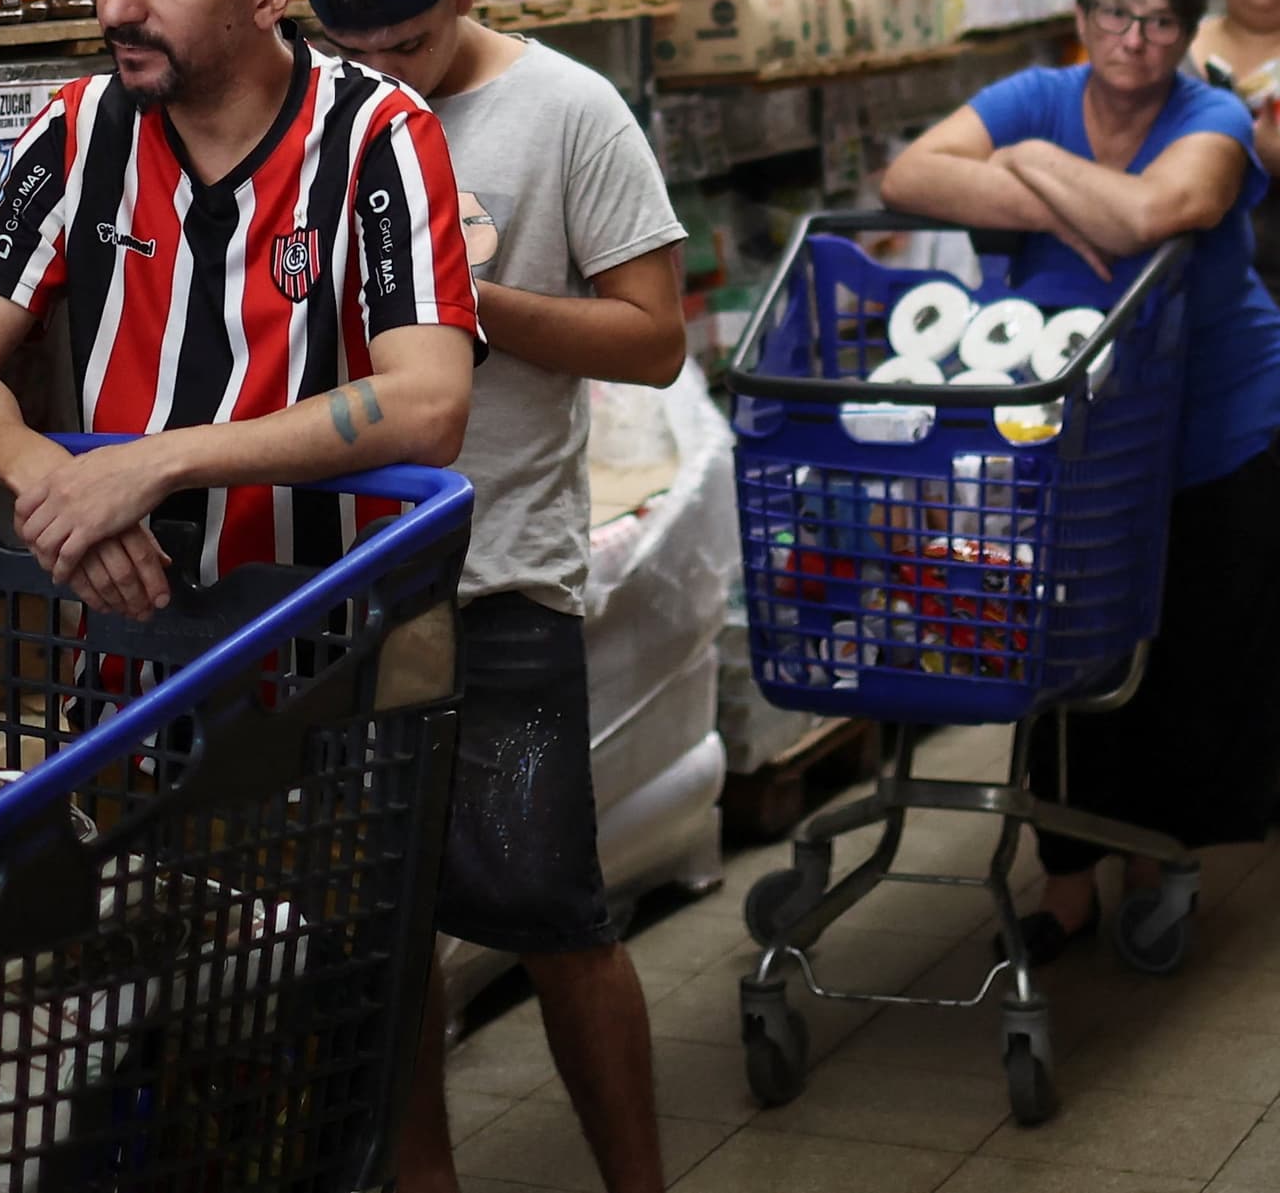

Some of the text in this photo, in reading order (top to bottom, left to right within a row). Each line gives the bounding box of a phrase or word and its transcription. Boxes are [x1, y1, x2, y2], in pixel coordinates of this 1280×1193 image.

[18, 165, 46, 196] MAS
[379, 217, 396, 294] Grup MAS
